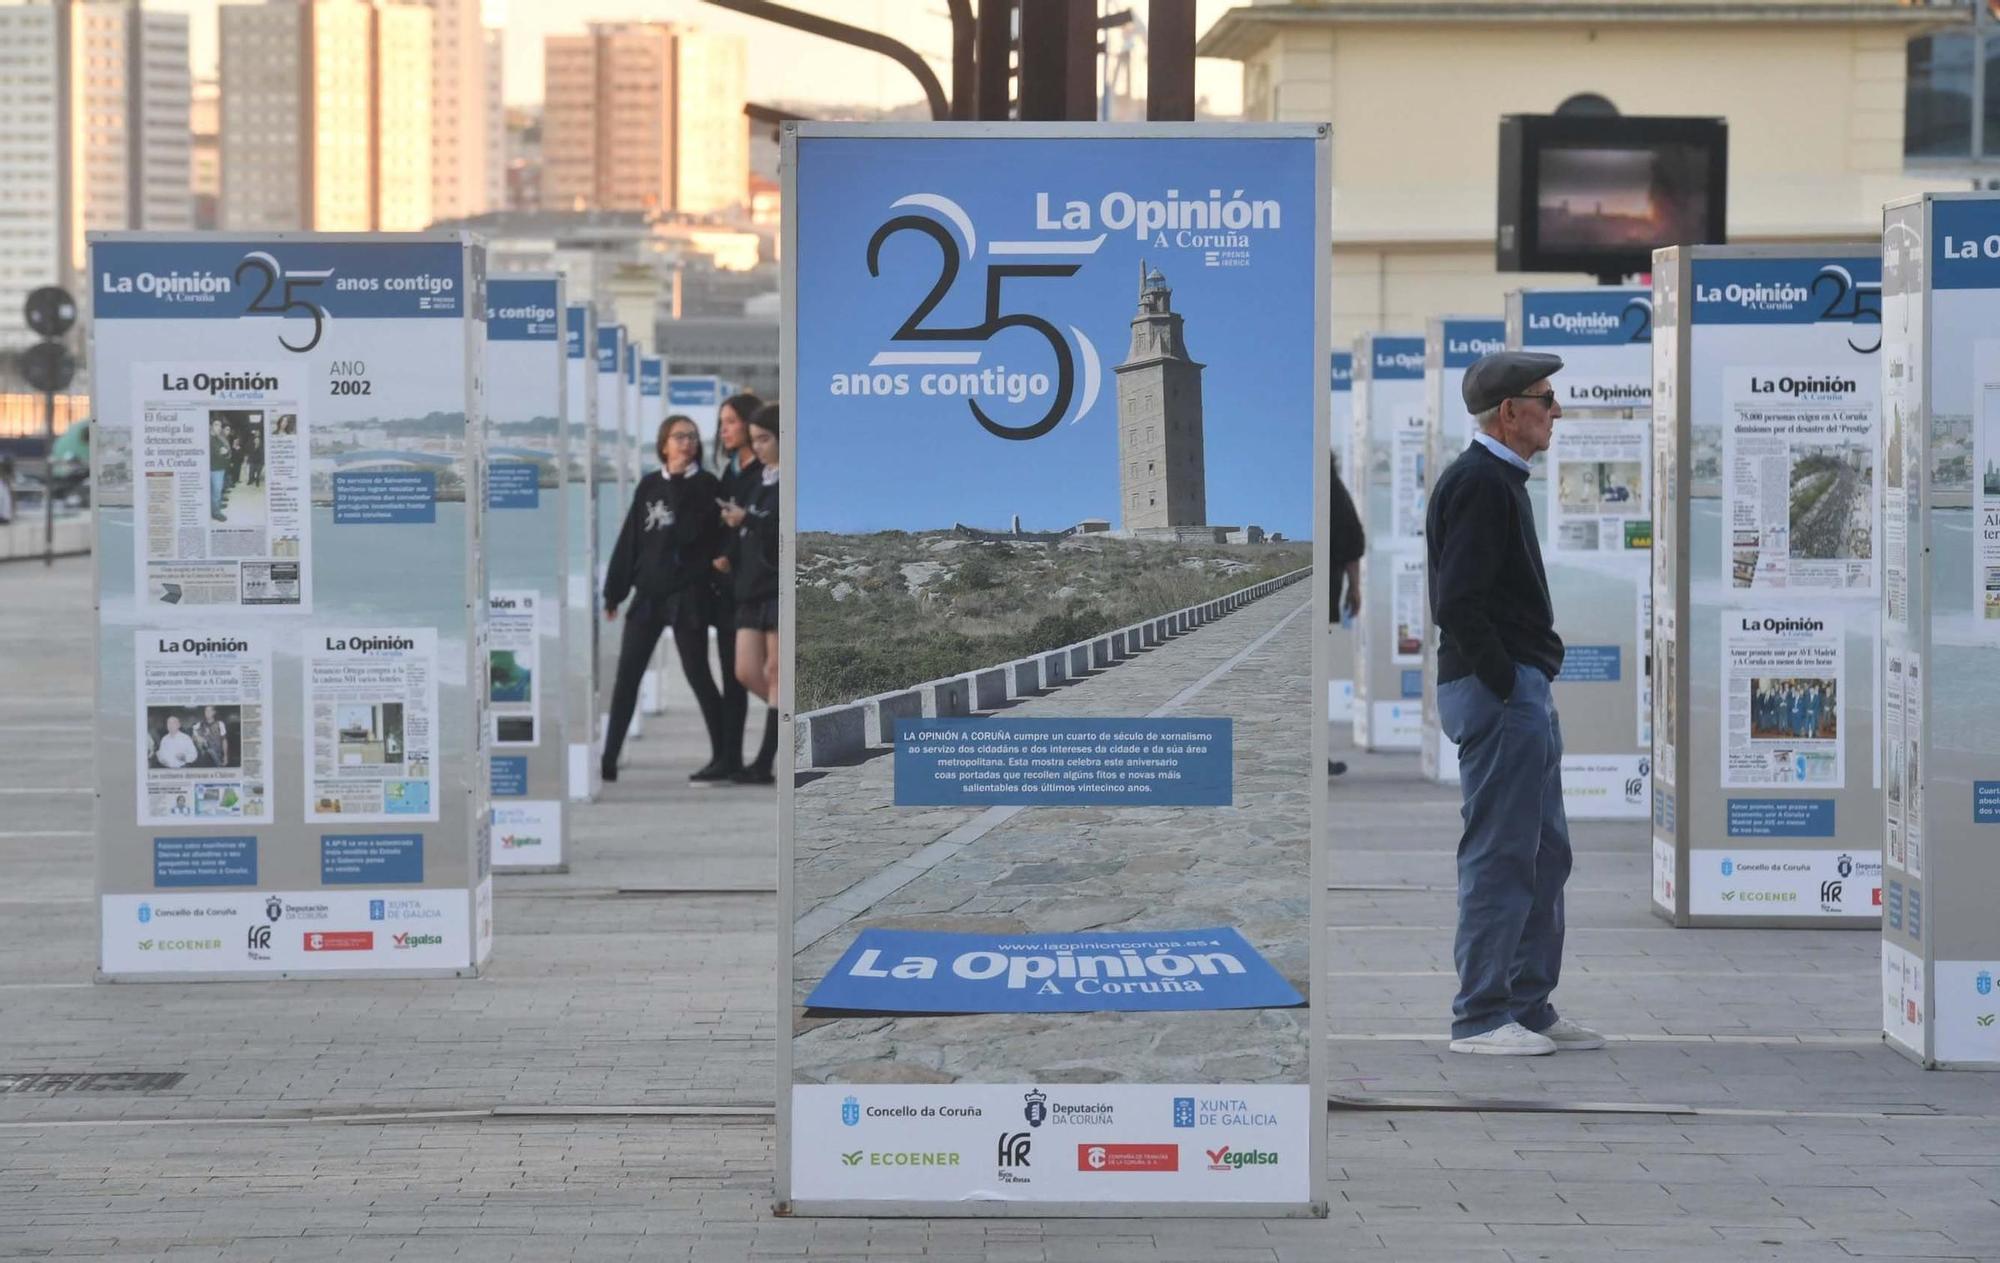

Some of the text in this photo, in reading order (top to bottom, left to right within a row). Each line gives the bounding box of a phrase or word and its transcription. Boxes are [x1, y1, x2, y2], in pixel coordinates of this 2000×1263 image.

[1036, 188, 1281, 240] La Opinión
[1153, 230, 1250, 249] A Coruña
[1945, 235, 1978, 259] La
[104, 271, 231, 297] La Opinión
[335, 274, 454, 296] anos contigo
[1696, 282, 1808, 306] La Opinión
[235, 258, 325, 353] 25
[500, 305, 555, 322] contigo
[867, 213, 1083, 441] 25
[1529, 311, 1619, 332] La Opinión
[1450, 338, 1505, 356] La Opin
[1377, 353, 1395, 366] La
[329, 361, 365, 376] ANO
[162, 372, 278, 395] La Opinión
[330, 380, 371, 396] 2002
[830, 366, 1050, 404] anos contigo
[1751, 375, 1856, 397] La Opinión
[1570, 384, 1652, 401] La Opinión
[1839, 411, 1868, 421] Coruña
[1742, 616, 1824, 634] La Opinión
[159, 637, 248, 656] La Opinión
[326, 635, 414, 654] La Opinión
[903, 732, 916, 741] LA
[918, 730, 958, 741] OPINIÓN
[961, 732, 969, 740] A
[971, 730, 1011, 741] CORUÑA
[1014, 733, 1049, 742] cumpre
[1099, 731, 1111, 741] de
[1114, 731, 1143, 741] século
[1146, 731, 1158, 741] de
[1161, 731, 1212, 741] xornalismo
[922, 745, 956, 753] servizo
[958, 745, 975, 753] dos
[977, 744, 1019, 753] cidadáns
[1030, 745, 1047, 753] dos
[1050, 745, 1092, 753] intereses
[1095, 744, 1107, 753] da
[1110, 744, 1141, 753] cidade
[1151, 744, 1164, 753] da
[1166, 744, 1183, 753] súa
[1186, 744, 1207, 753] área
[937, 757, 1178, 768] metropolitana. Esta mostra celebra este aniversario
[934, 771, 956, 779] coas
[959, 770, 1000, 780] portadas
[1003, 771, 1021, 780] que
[1023, 770, 1060, 779] recollen
[1063, 770, 1094, 780] algúns
[1096, 770, 1117, 779] fitos
[1158, 770, 1181, 779] máis
[962, 783, 1018, 792] salientables
[1021, 783, 1038, 792] dos
[1041, 783, 1075, 792] últimos
[1078, 783, 1125, 792] vintecinco
[1736, 862, 1811, 871] Concello da Coruña
[1739, 893, 1797, 901] ECOENER
[155, 907, 237, 917] Concello da Coruña
[158, 939, 222, 950] ECOENER
[392, 932, 442, 948] Vegalsa
[998, 938, 1208, 952] www.laopinioncoruna.es
[848, 947, 1248, 989] La Opinión
[1036, 976, 1205, 995] A Coruña
[866, 1106, 982, 1117] Concello da Coruña
[1052, 1103, 1114, 1115] Deputación
[1200, 1100, 1248, 1112] XUNTA
[1052, 1113, 1114, 1125] DA CORUÑA
[1199, 1114, 1277, 1126] DE GALICIA
[870, 1152, 960, 1165] ECOENER
[1206, 1146, 1278, 1168] Vegalsa
